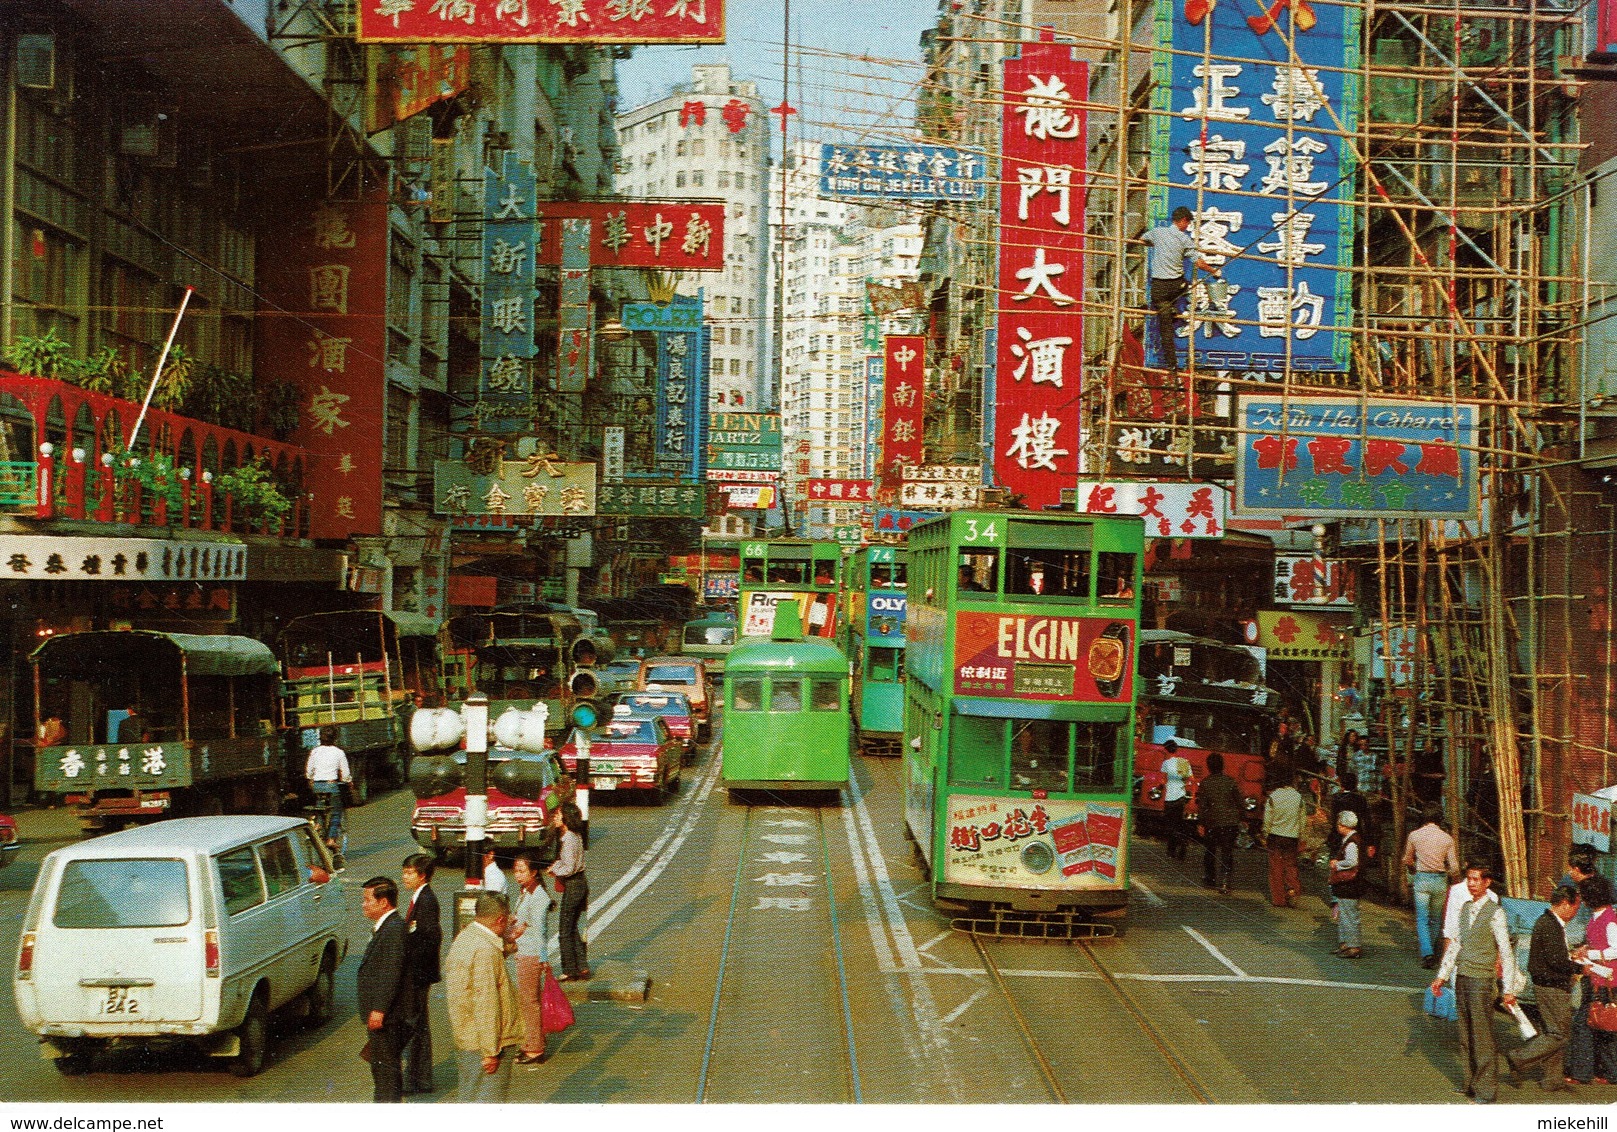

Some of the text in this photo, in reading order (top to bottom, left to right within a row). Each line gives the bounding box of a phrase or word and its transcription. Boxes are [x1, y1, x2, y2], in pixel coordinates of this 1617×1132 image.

[1004, 74, 1079, 472] 龍門大酒樓
[488, 183, 526, 393] 大新眼鏡
[624, 308, 700, 326] ROLEX
[890, 345, 918, 478] 中南銀行
[964, 520, 998, 541] 34
[745, 543, 764, 556] 66
[873, 549, 892, 561] 74
[871, 597, 907, 611] OLY
[997, 617, 1079, 661] ELGIN
[786, 656, 795, 668] 4
[98, 999, 140, 1014] 1242
